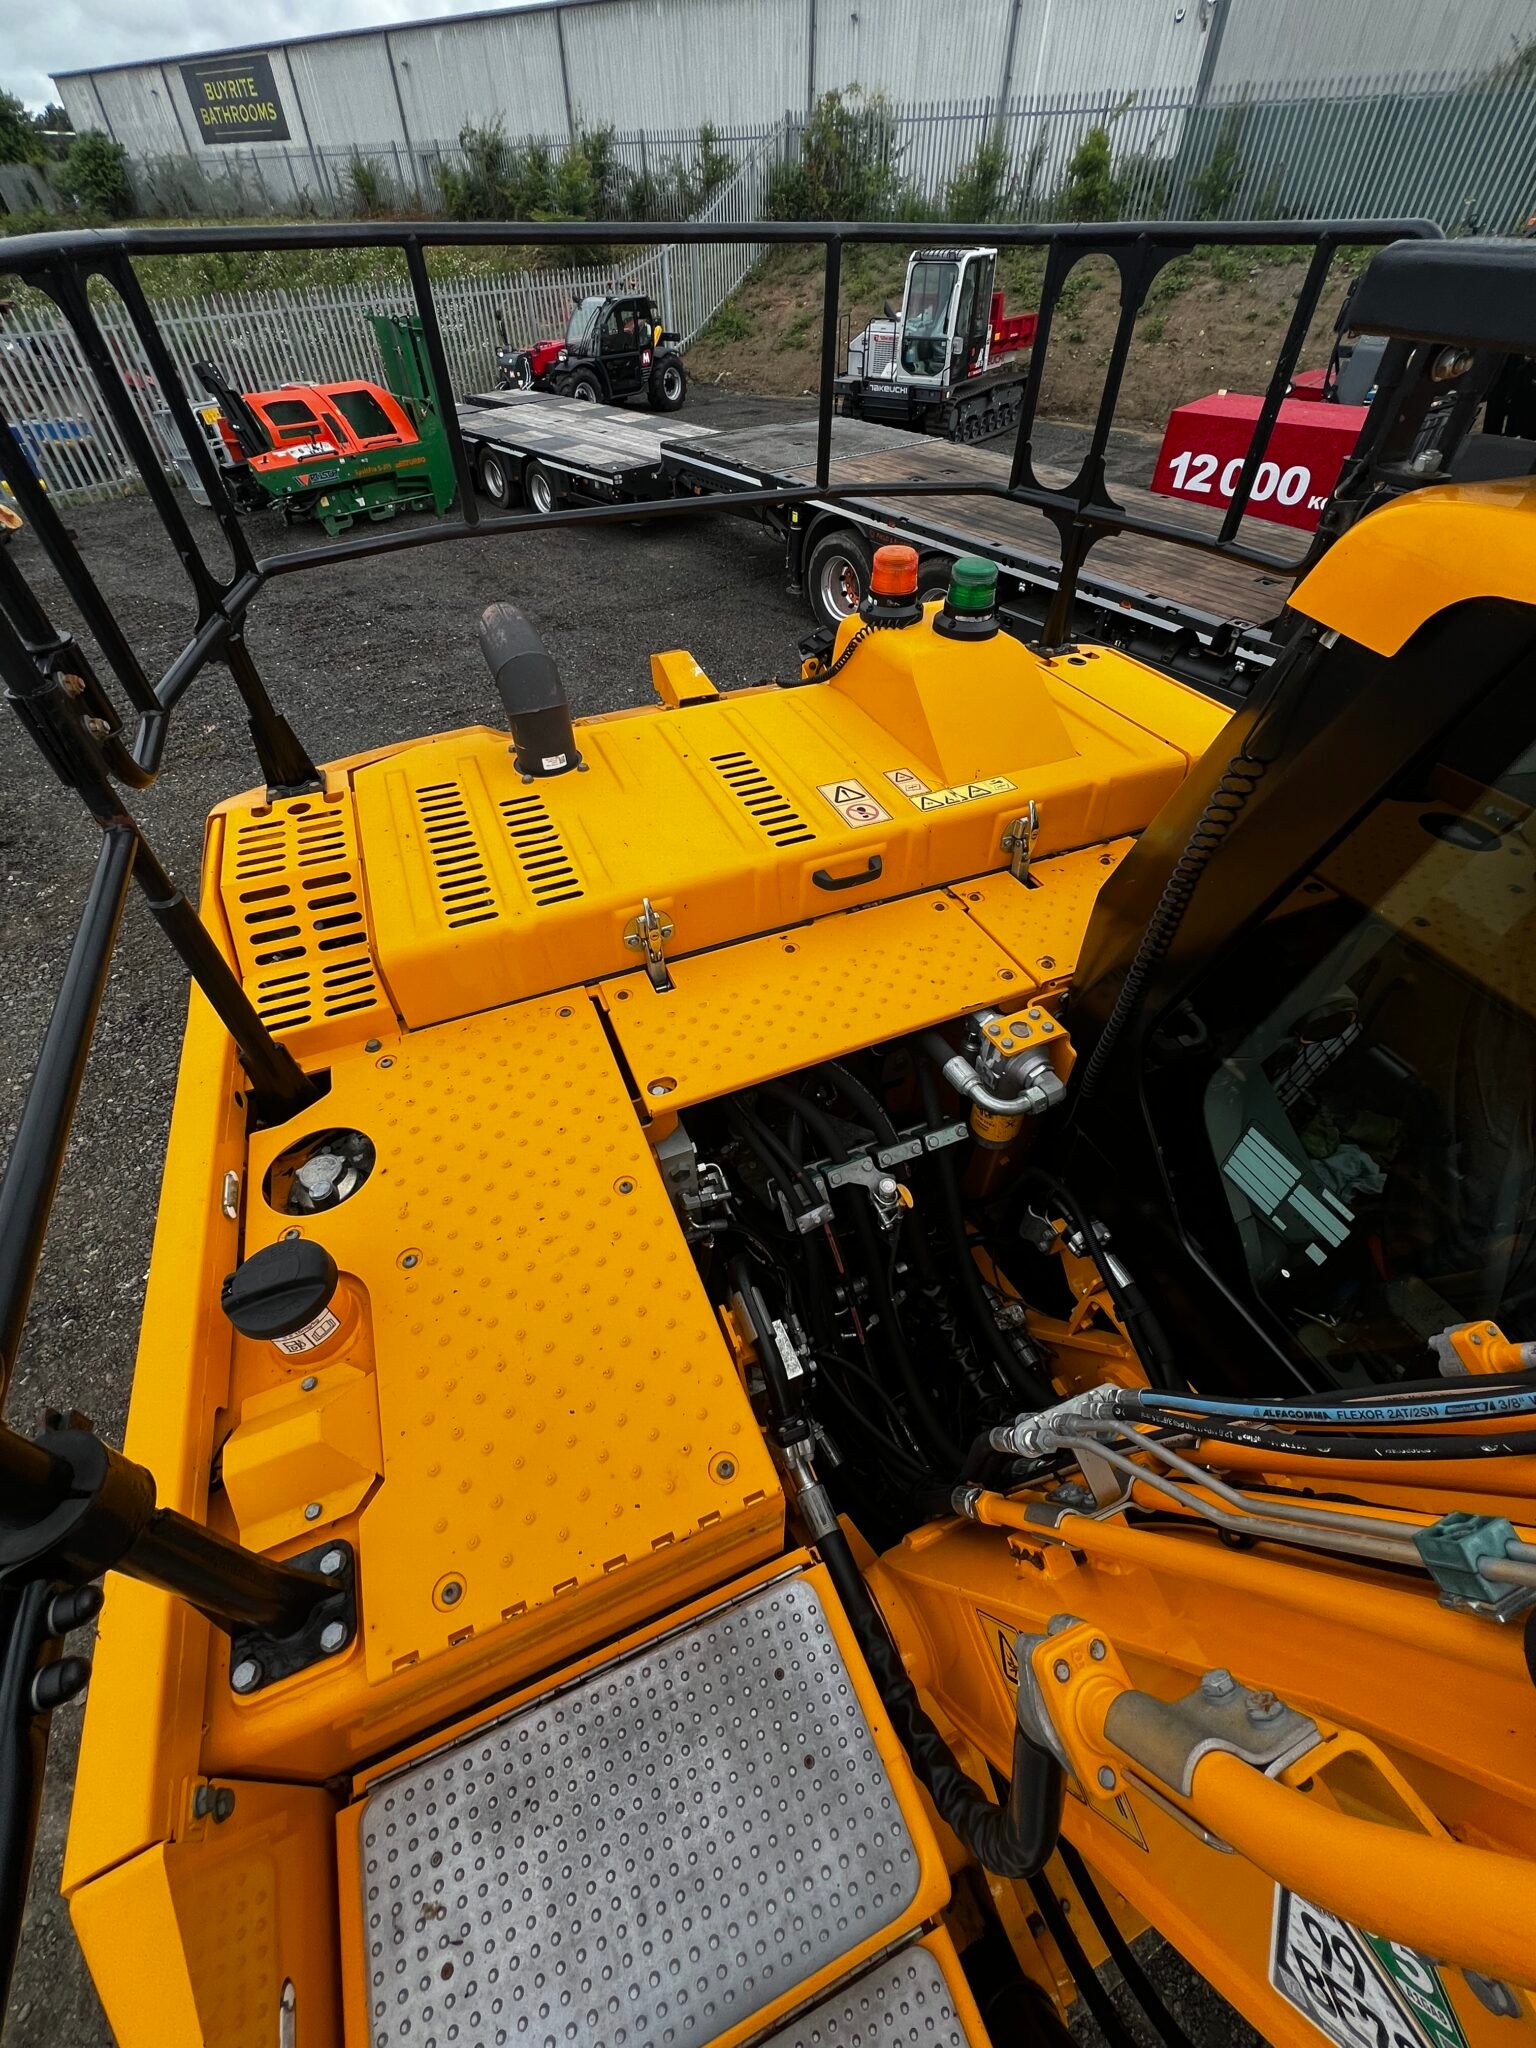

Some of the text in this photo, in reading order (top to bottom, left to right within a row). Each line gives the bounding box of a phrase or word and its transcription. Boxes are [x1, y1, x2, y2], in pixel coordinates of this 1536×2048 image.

[203, 77, 258, 101] BUYRITE
[200, 102, 278, 125] BATHROOMS
[1263, 1409, 1332, 1420] ALFAGOMMA
[1336, 1409, 1385, 1420] FLEXOR
[1388, 1406, 1440, 1419] 2AT/2SN
[1498, 1398, 1525, 1410] 3/8"
